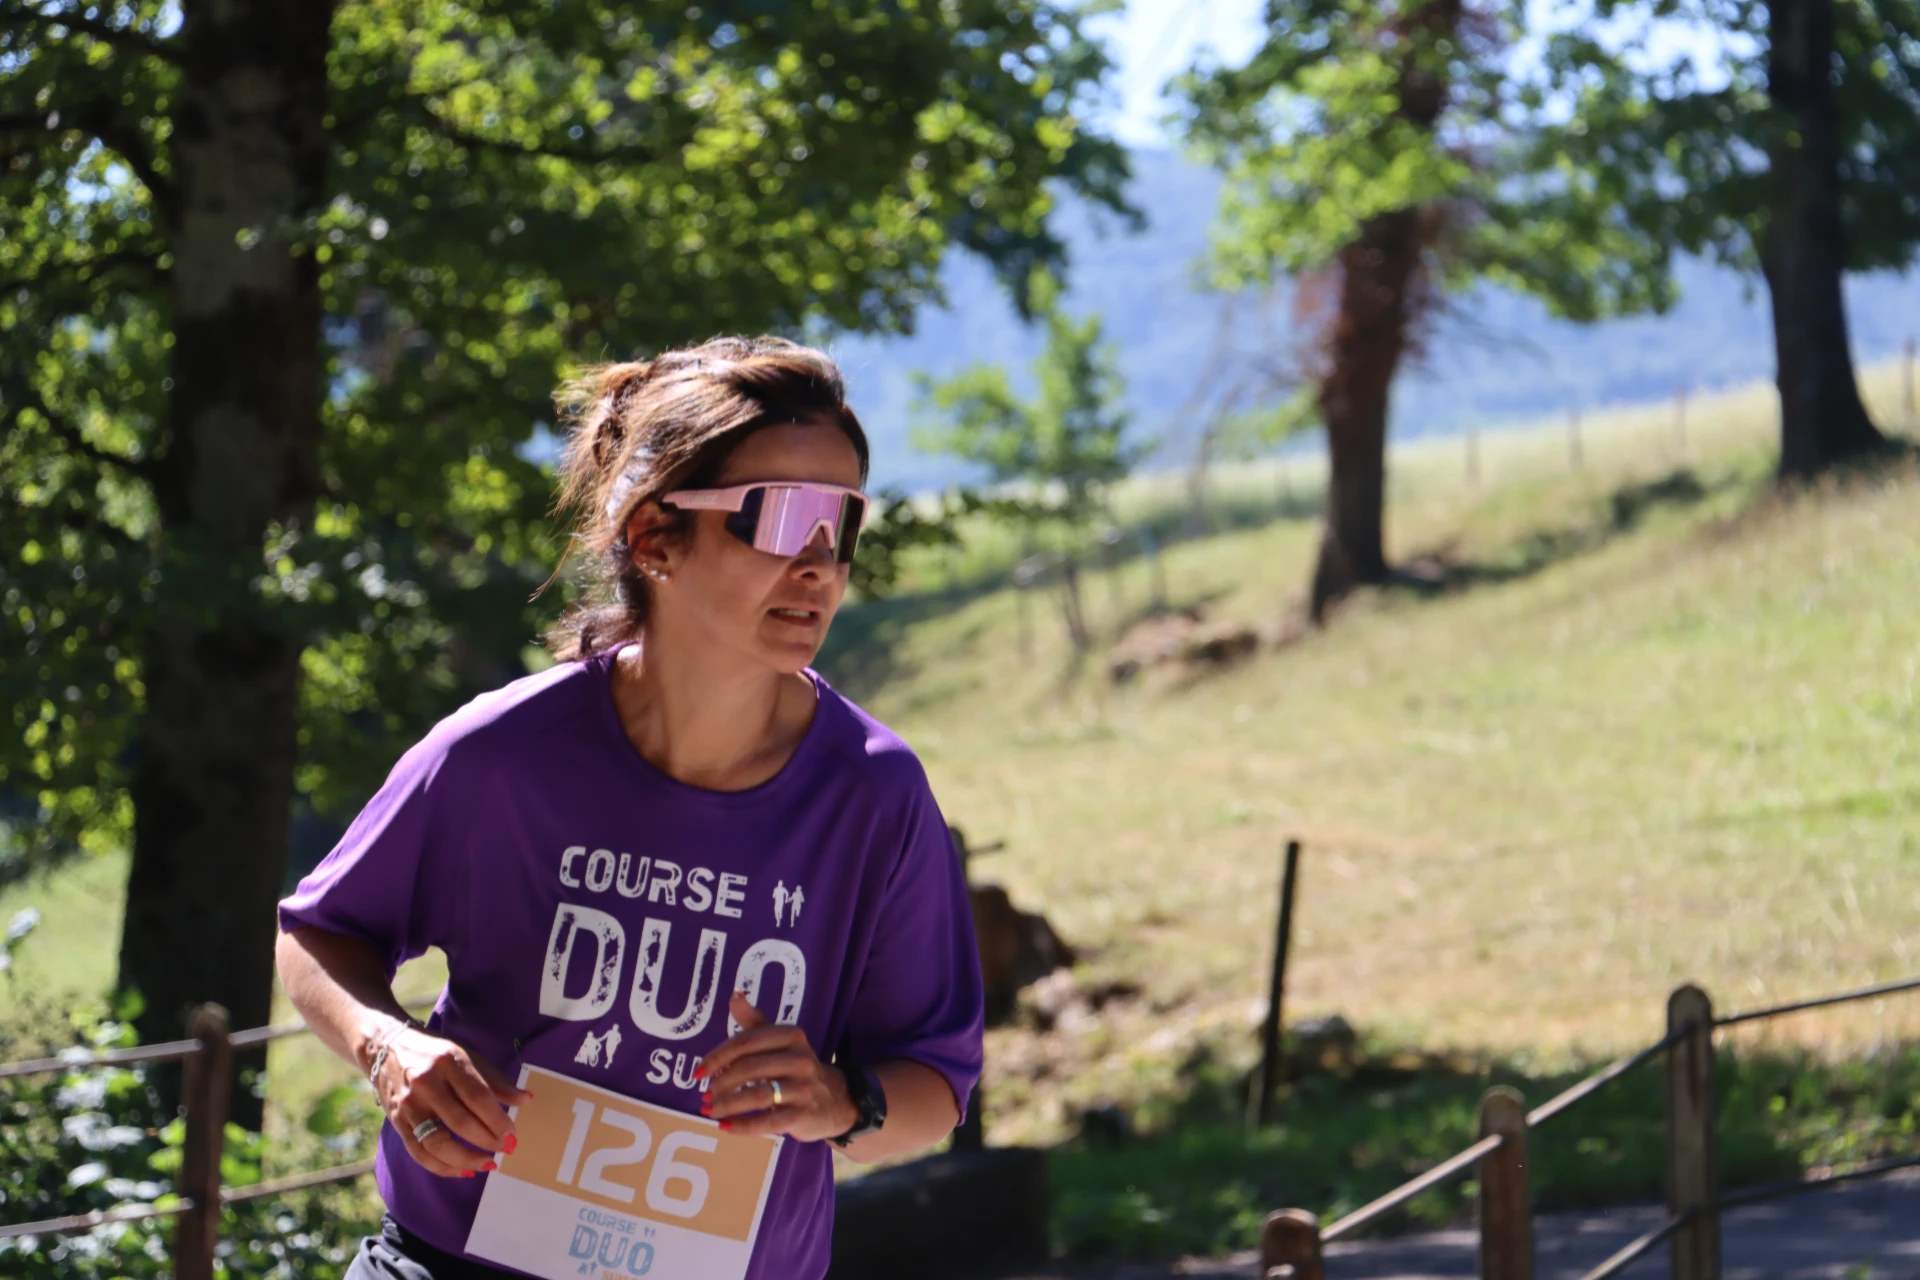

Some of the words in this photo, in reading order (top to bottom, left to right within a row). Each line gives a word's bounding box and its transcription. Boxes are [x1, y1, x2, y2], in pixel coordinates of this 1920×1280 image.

[559, 846, 748, 919] COURSE
[538, 902, 806, 1041] DUO
[556, 1098, 718, 1218] 126
[568, 1223, 655, 1276] DUO
[578, 1207, 638, 1235] COURSE
